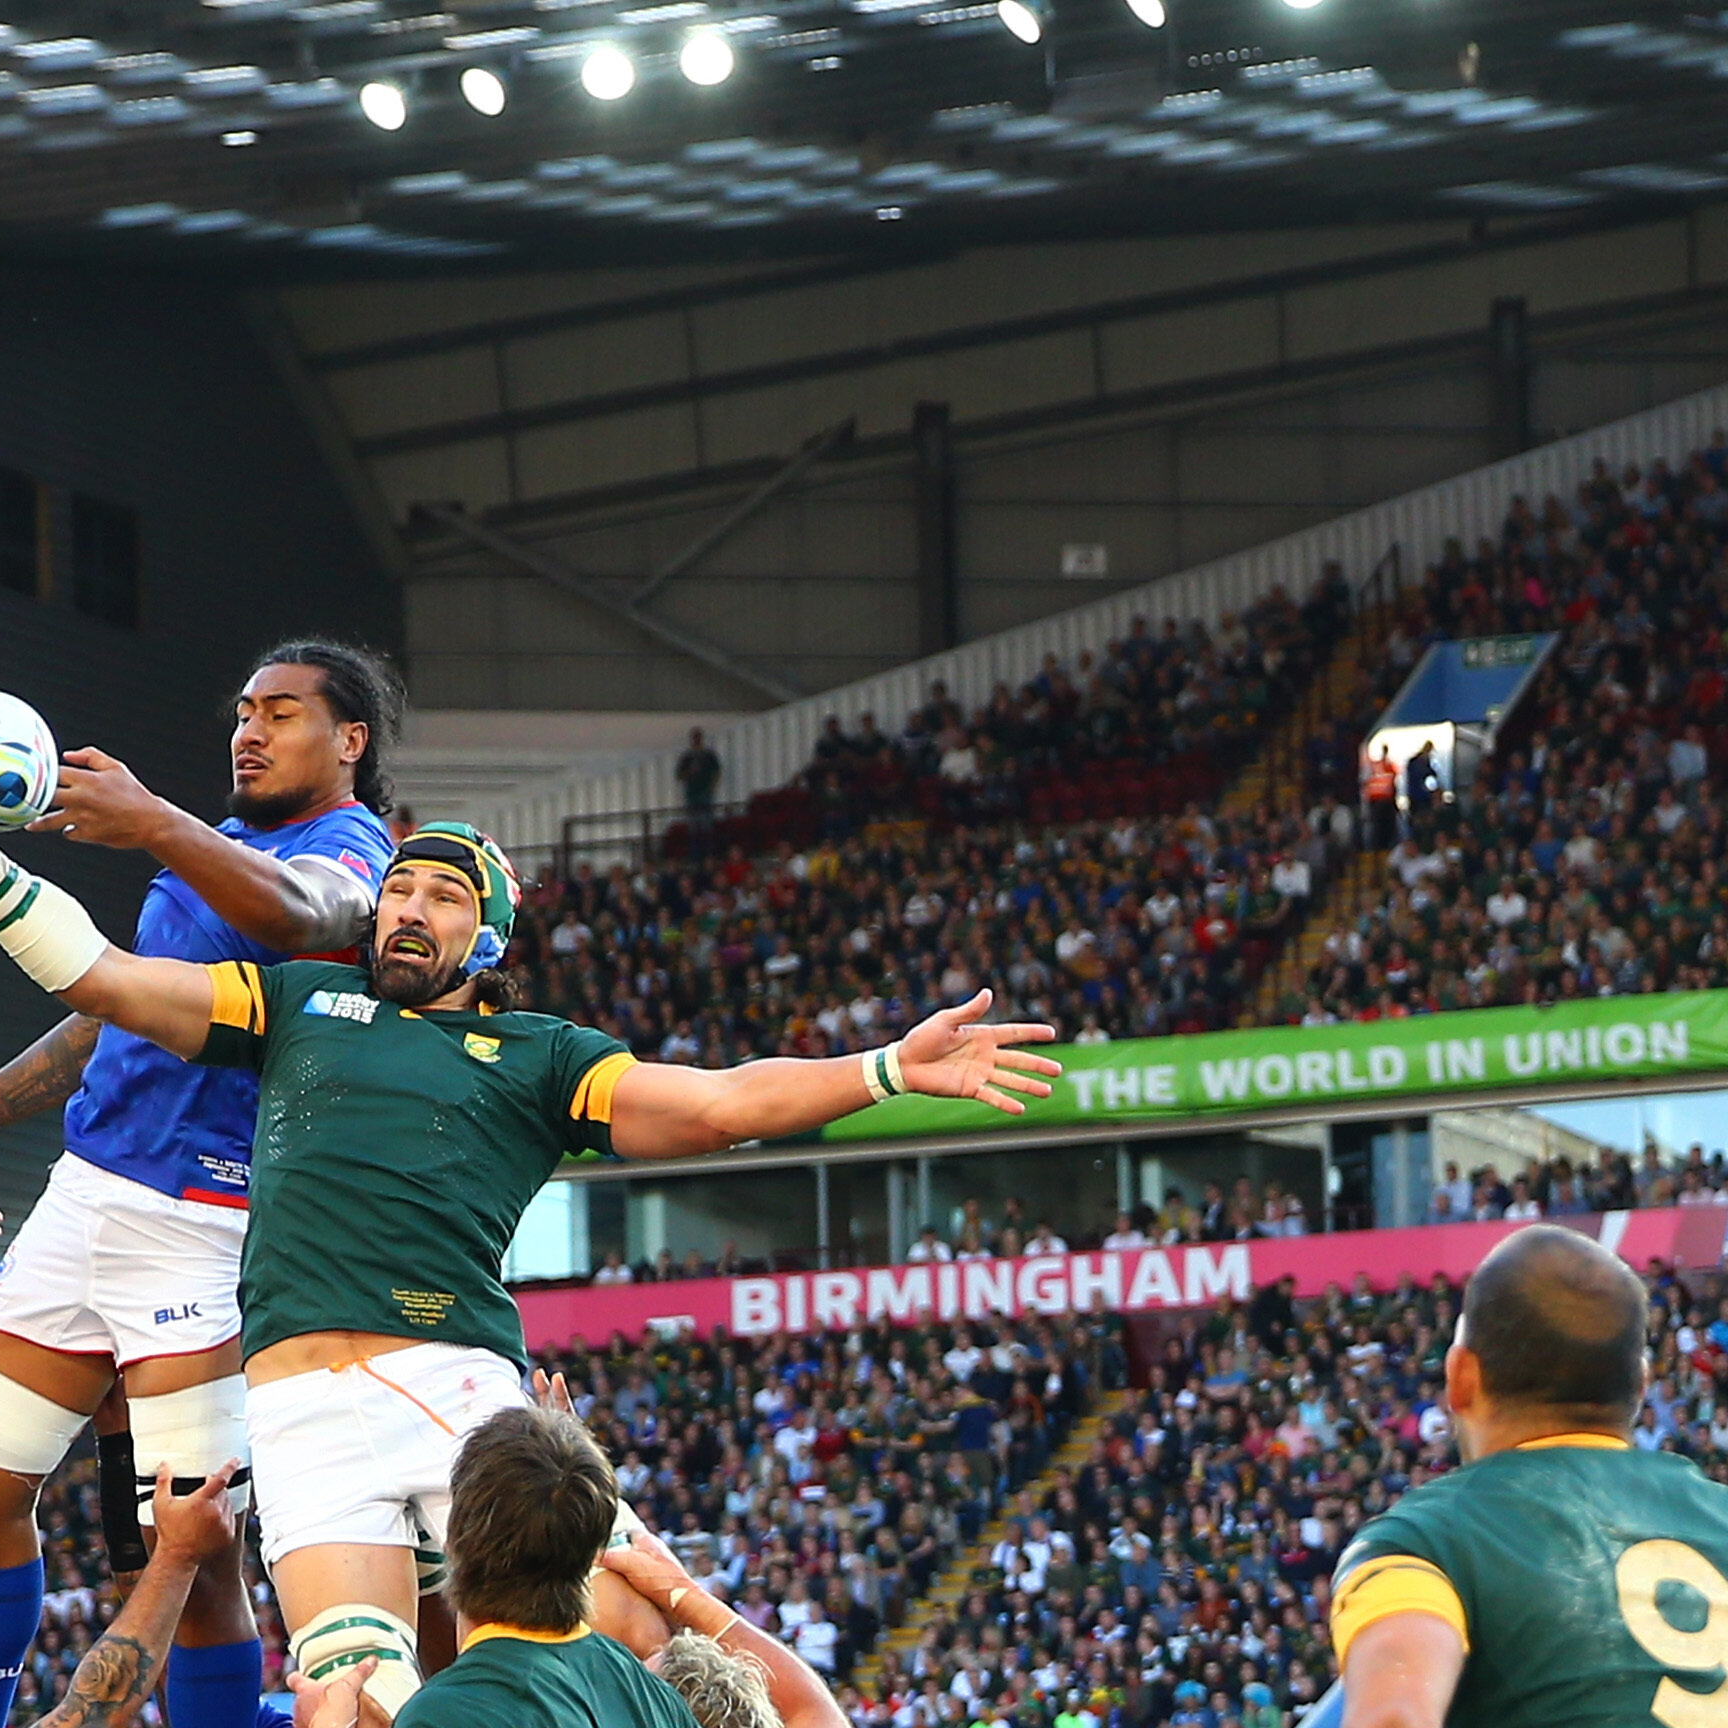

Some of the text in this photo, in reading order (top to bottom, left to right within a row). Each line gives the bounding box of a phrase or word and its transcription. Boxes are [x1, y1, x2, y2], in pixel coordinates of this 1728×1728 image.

[1068, 1020, 1689, 1111] THE WORLD IN UNION
[153, 1302, 203, 1324] BLK
[732, 1243, 1251, 1336] BIRMINGHAM
